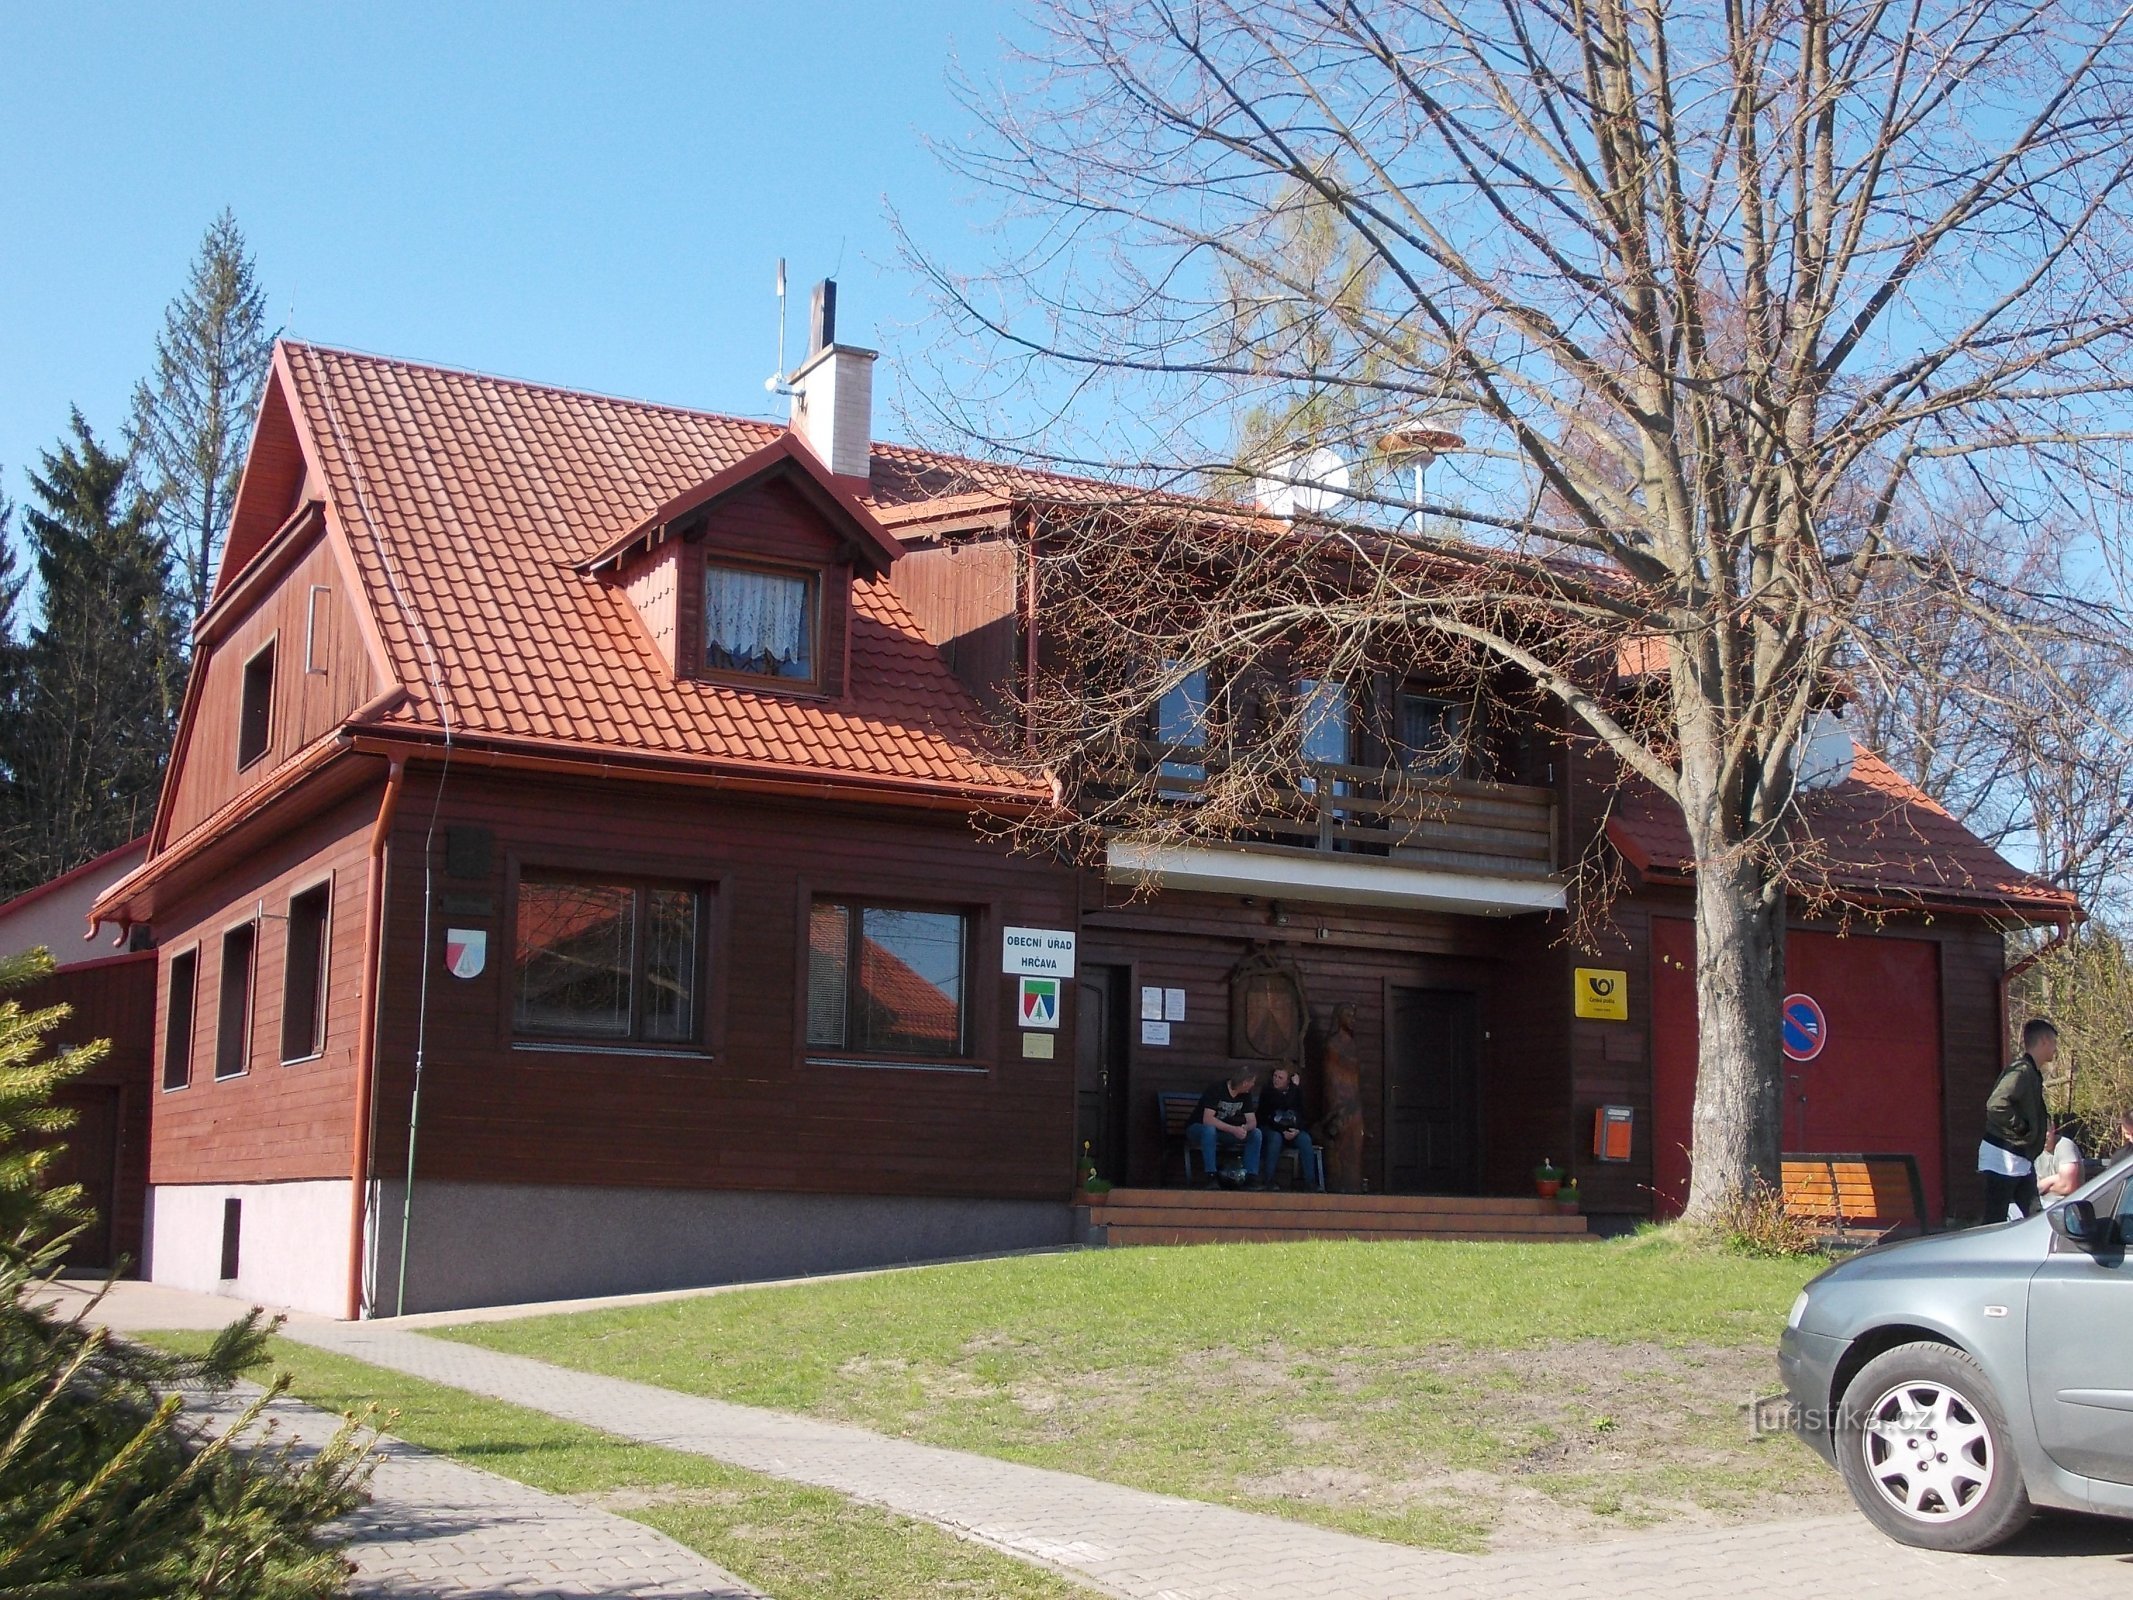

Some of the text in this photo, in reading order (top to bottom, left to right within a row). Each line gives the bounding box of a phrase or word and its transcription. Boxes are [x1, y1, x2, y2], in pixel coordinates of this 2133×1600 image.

[1007, 936, 1072, 950] OBECNÍ ÚŘAD
[1021, 956, 1057, 969] HRČAVA
